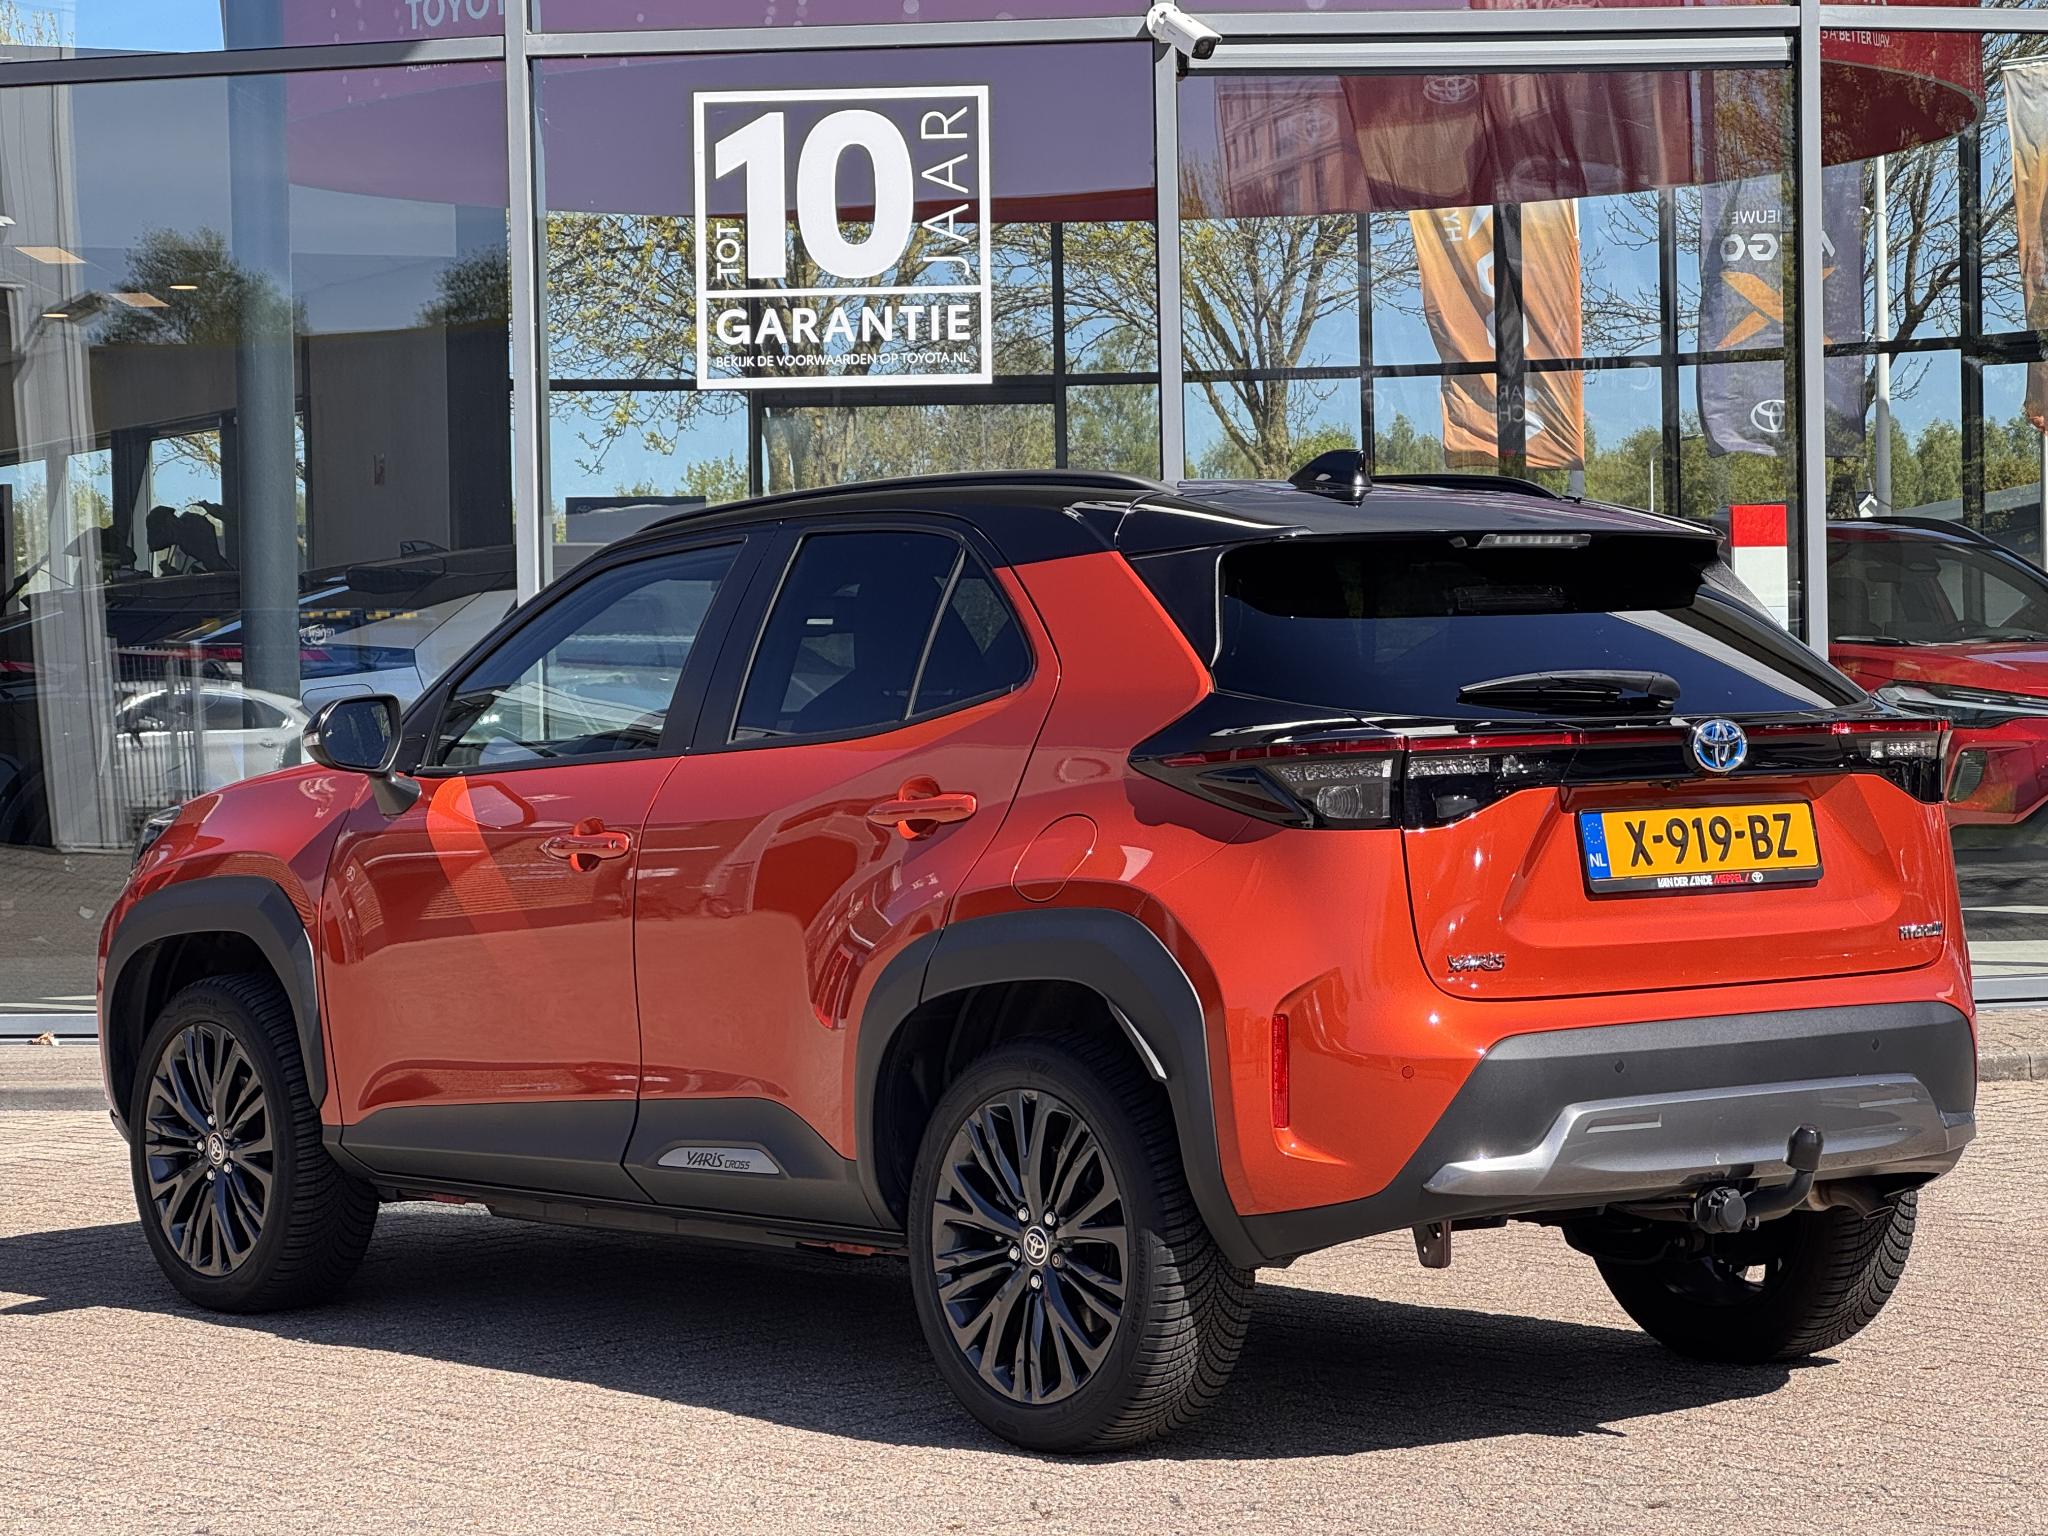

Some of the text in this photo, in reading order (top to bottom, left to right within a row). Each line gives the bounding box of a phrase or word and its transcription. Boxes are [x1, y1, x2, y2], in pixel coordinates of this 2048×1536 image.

[715, 109, 914, 279] 10
[921, 106, 969, 275] JAAR
[717, 222, 740, 279] TOT
[717, 304, 971, 345] GARANTIE
[717, 351, 971, 367] BEKIJK DE VOORWAARDEN OP TOYOTA.NL
[1589, 852, 1607, 868] NL
[1625, 812, 1799, 868] X-919-BZ
[1657, 873, 1744, 888] VAN DER LINDE MEPPEL
[724, 1159, 751, 1170] CROSS
